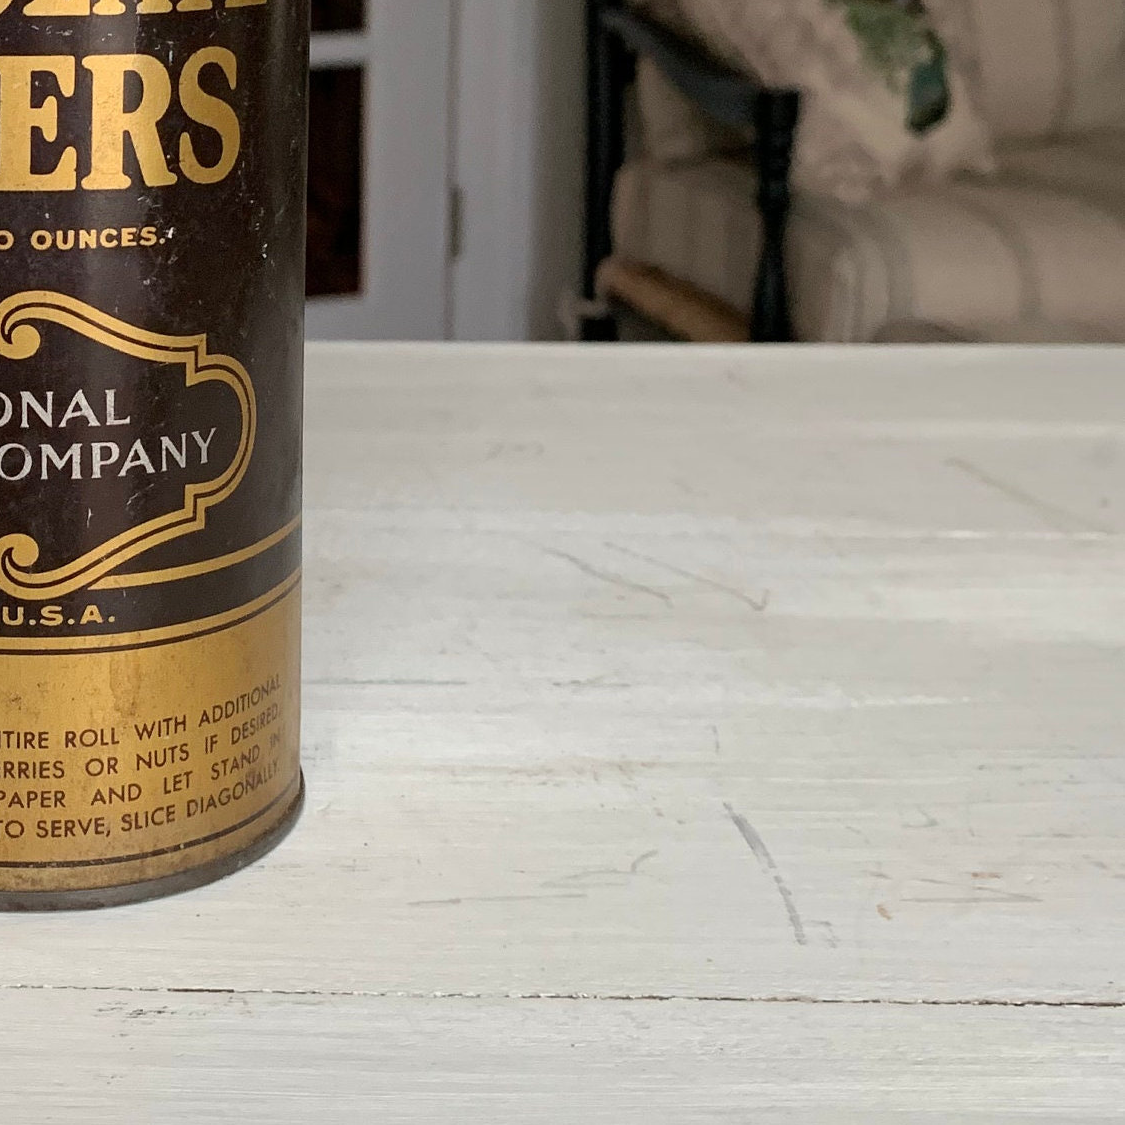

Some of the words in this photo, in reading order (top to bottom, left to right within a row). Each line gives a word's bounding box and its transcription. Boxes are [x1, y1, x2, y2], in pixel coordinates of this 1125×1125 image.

[30, 226, 167, 251] OUNCES.
[1, 604, 117, 626] U.S.A.
[65, 727, 120, 750] ROLL
[134, 714, 187, 741] WITH
[198, 674, 282, 728] ADDITIONAL
[85, 757, 119, 777] OR
[136, 742, 190, 772] NUTS
[205, 734, 219, 755] IF
[90, 783, 143, 807] AND
[163, 770, 194, 795] LET
[210, 754, 261, 781] STAND
[35, 816, 112, 839] SERVE,
[121, 804, 176, 833] SLICE
